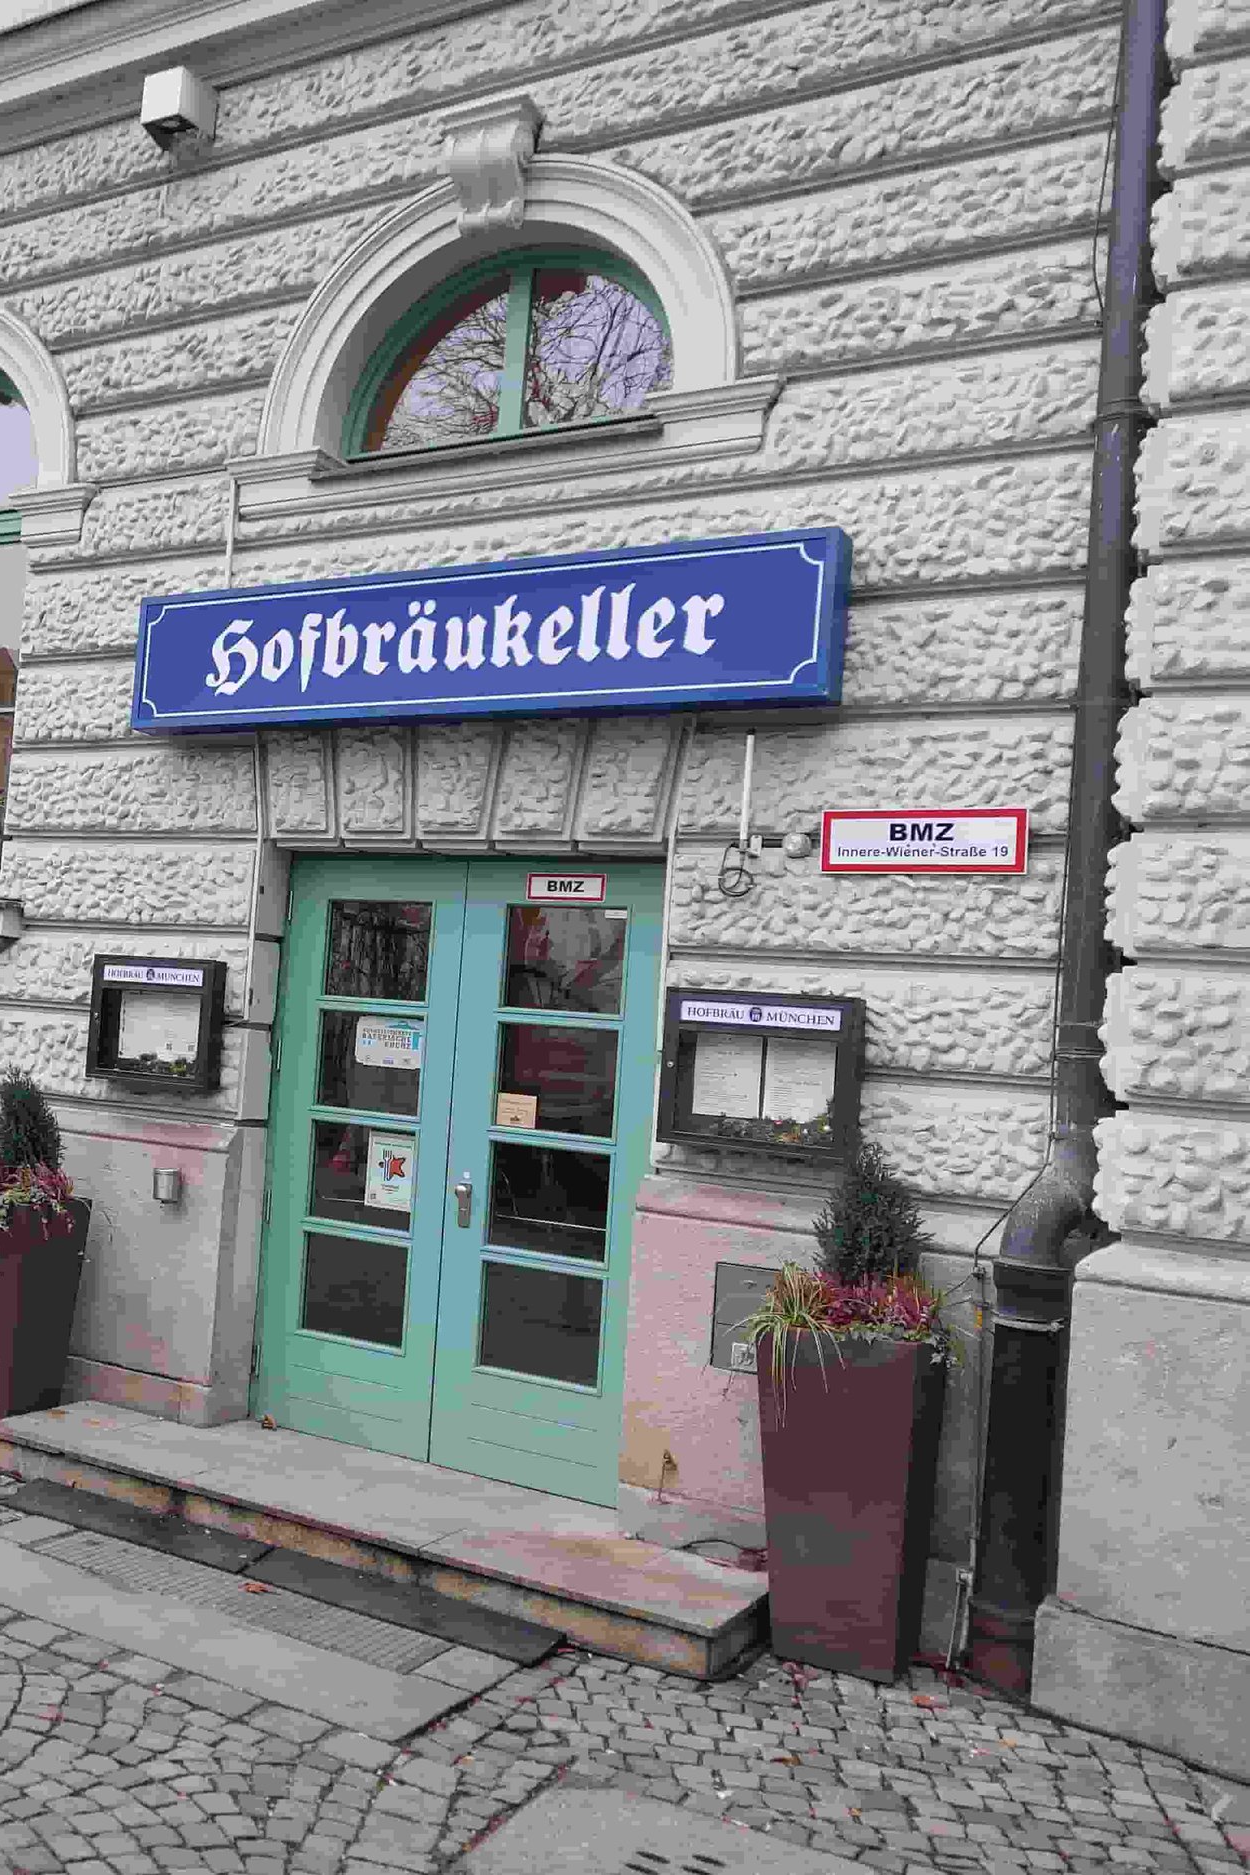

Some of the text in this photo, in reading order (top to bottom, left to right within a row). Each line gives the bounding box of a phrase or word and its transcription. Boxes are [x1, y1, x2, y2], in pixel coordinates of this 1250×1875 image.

[205, 582, 726, 697] Hofbräukeller
[889, 822, 955, 842] BMZ
[837, 845, 1010, 858] Innere-Wiener-Straße 19
[546, 880, 586, 893] BMZ
[687, 1006, 836, 1026] HOFBRÄU MÜNCHEN
